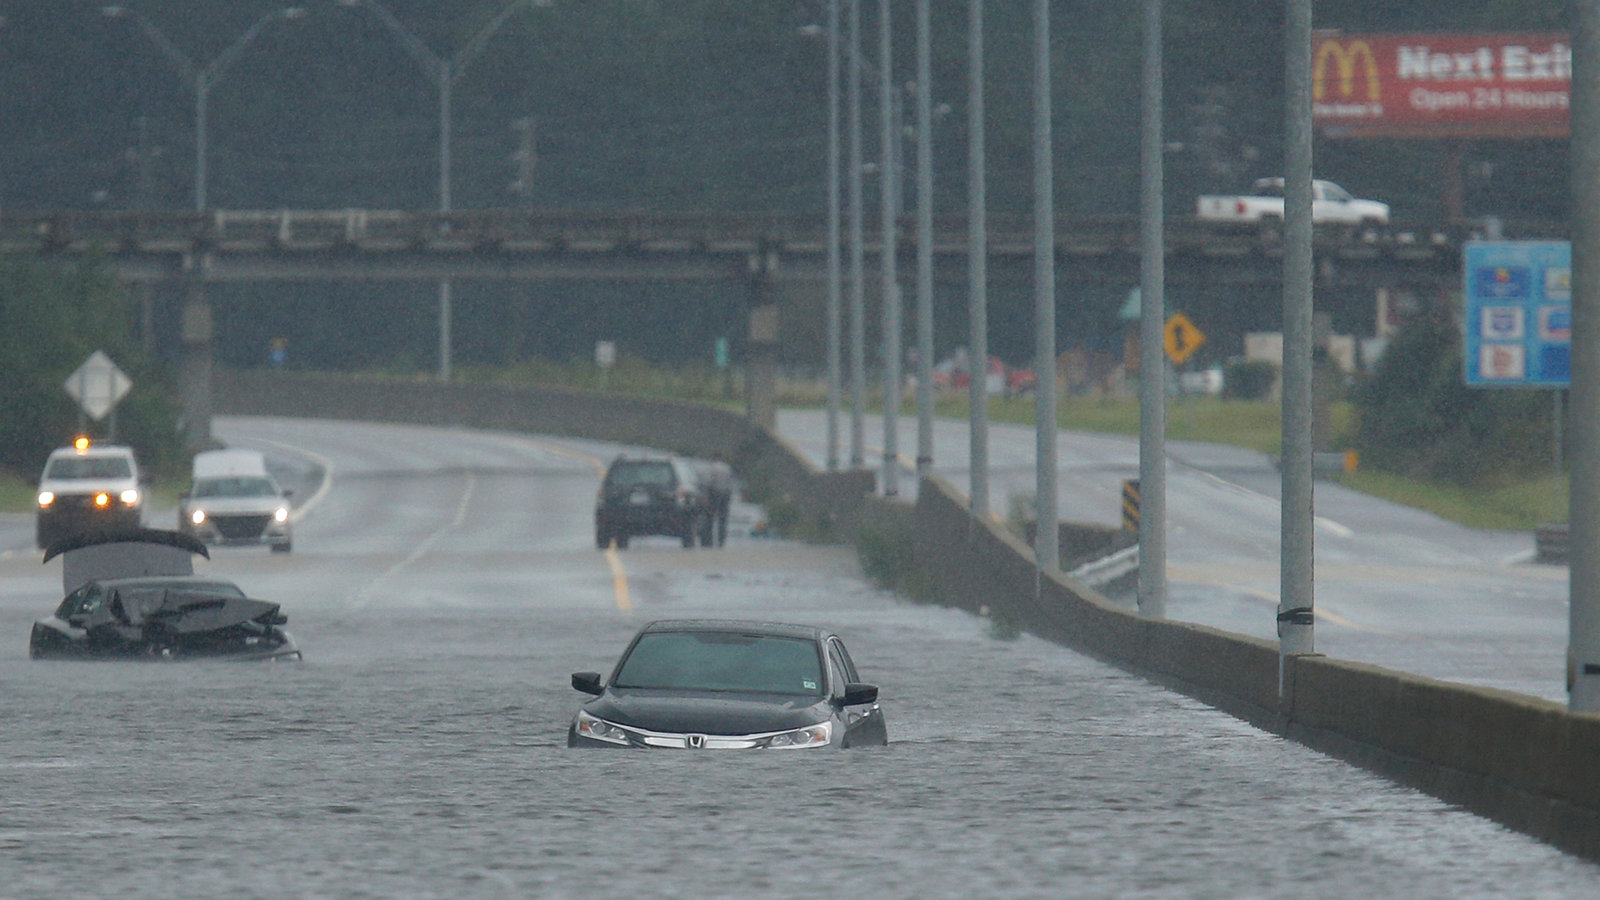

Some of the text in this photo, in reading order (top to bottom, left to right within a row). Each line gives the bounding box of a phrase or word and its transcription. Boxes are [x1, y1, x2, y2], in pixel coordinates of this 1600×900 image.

[1397, 46, 1494, 79] Next
[1409, 87, 1469, 110] Open
[1472, 87, 1501, 109] 24
[1504, 87, 1570, 109] Hours
